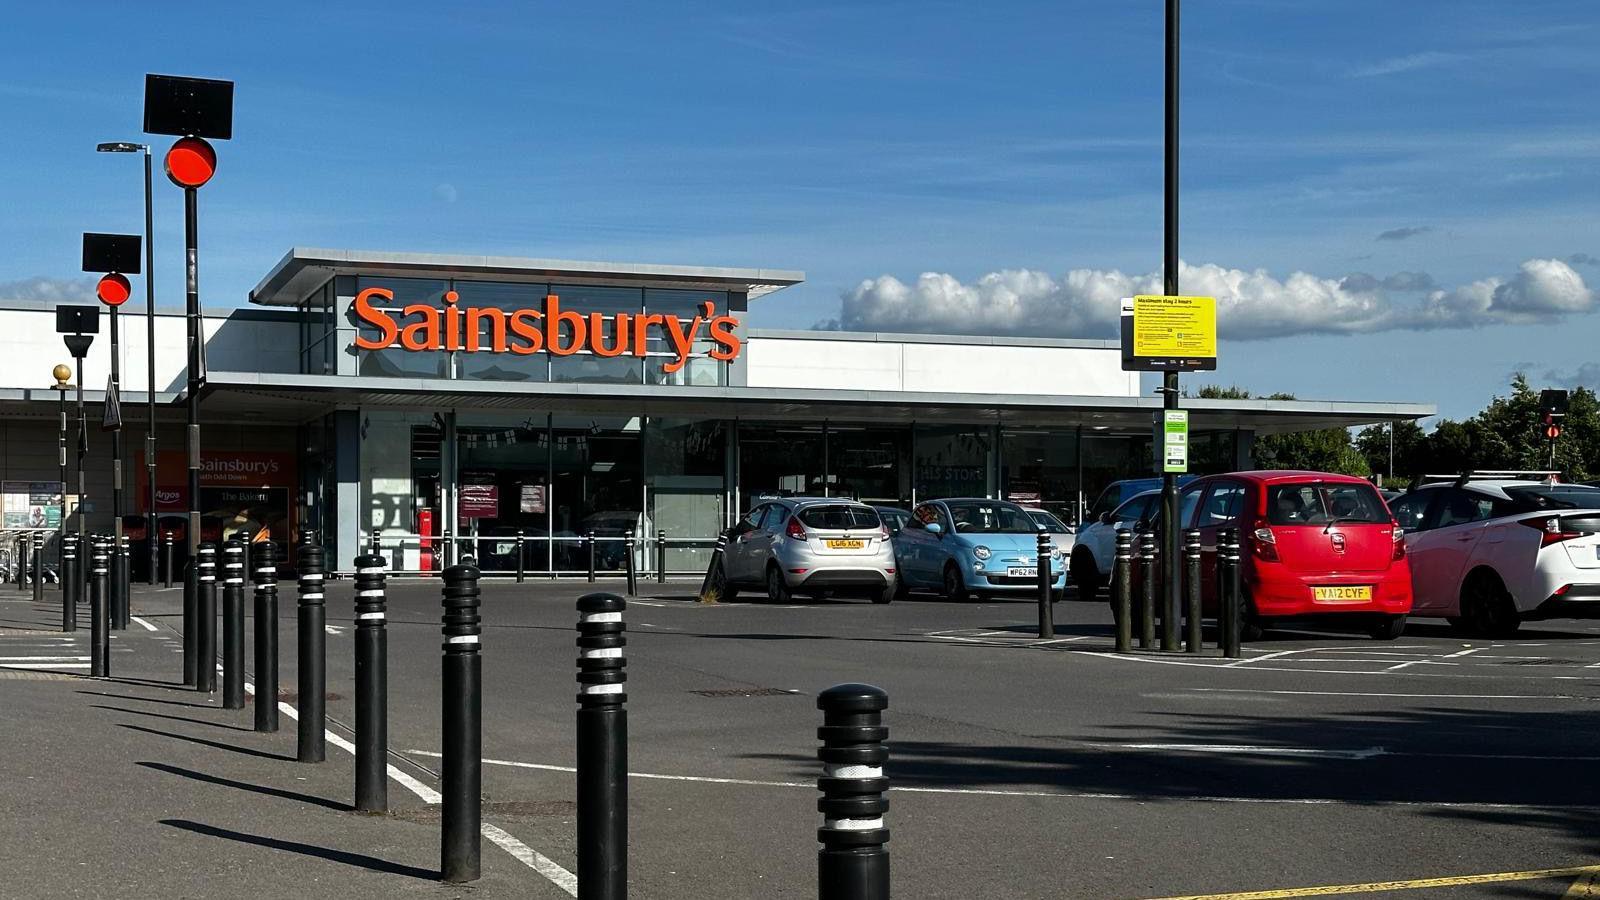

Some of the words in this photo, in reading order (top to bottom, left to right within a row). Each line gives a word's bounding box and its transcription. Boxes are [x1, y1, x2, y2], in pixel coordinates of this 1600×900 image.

[354, 287, 741, 373] Sainsbury's
[200, 458, 279, 474] Sainsbury's
[156, 490, 180, 501] Argos
[1345, 588, 1364, 598] CYF
